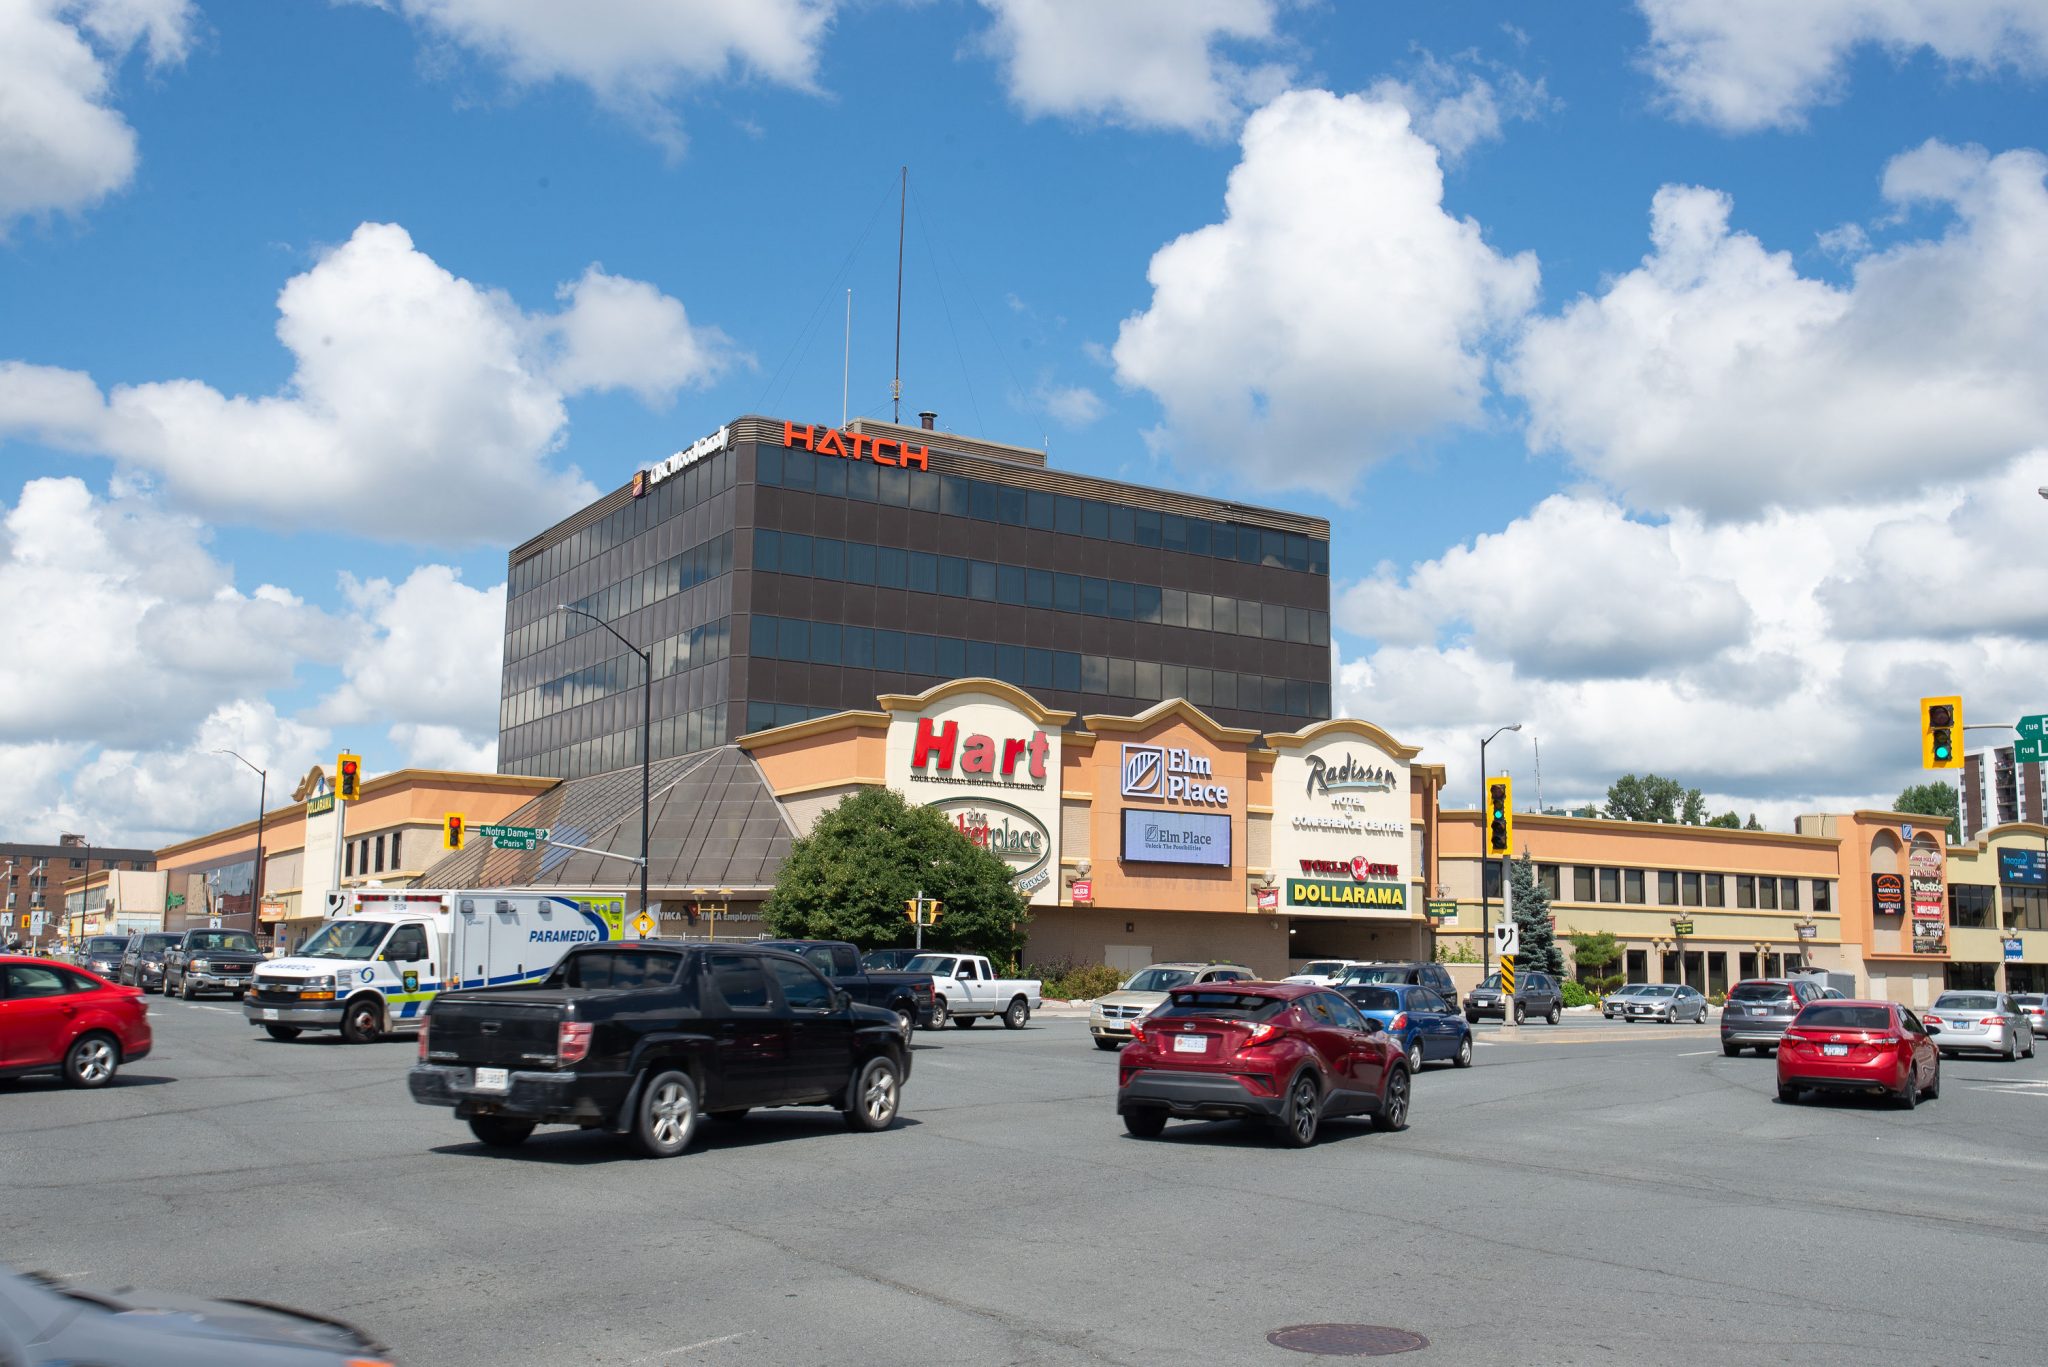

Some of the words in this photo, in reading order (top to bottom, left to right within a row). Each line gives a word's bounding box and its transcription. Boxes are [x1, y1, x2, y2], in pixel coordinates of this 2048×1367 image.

[784, 420, 929, 472] HATCH
[2025, 723, 2039, 731] rue
[911, 717, 1050, 779] Hart
[2021, 746, 2035, 754] rue
[1167, 748, 1213, 776] Elm
[910, 774, 929, 782] YOUR
[930, 776, 966, 785] CANADIAN
[967, 779, 1001, 788] SHOPPING
[1003, 781, 1045, 792] EXPERIENCE
[1305, 752, 1397, 799] Radisson
[1167, 775, 1229, 804] Place
[966, 807, 988, 821] the
[485, 826, 506, 837] Notre
[507, 827, 529, 838] Dame
[956, 812, 1042, 854] ketplace
[1291, 815, 1362, 832] CONFERENCE
[1364, 819, 1404, 835] CENTRE
[503, 839, 520, 848] Paris
[1159, 830, 1180, 843] Elm
[1183, 831, 1212, 845] Place
[1145, 842, 1162, 850] Unlock
[1172, 844, 1202, 852] Possibilities
[1299, 859, 1350, 874] WORLD
[1368, 862, 1399, 877] GYM
[1019, 868, 1050, 891] Grocer
[1912, 878, 1944, 893] Pesto's
[1294, 883, 1404, 905] DOLLARAMA
[660, 911, 682, 921] YMCA
[528, 929, 597, 943] PARAMEDIC
